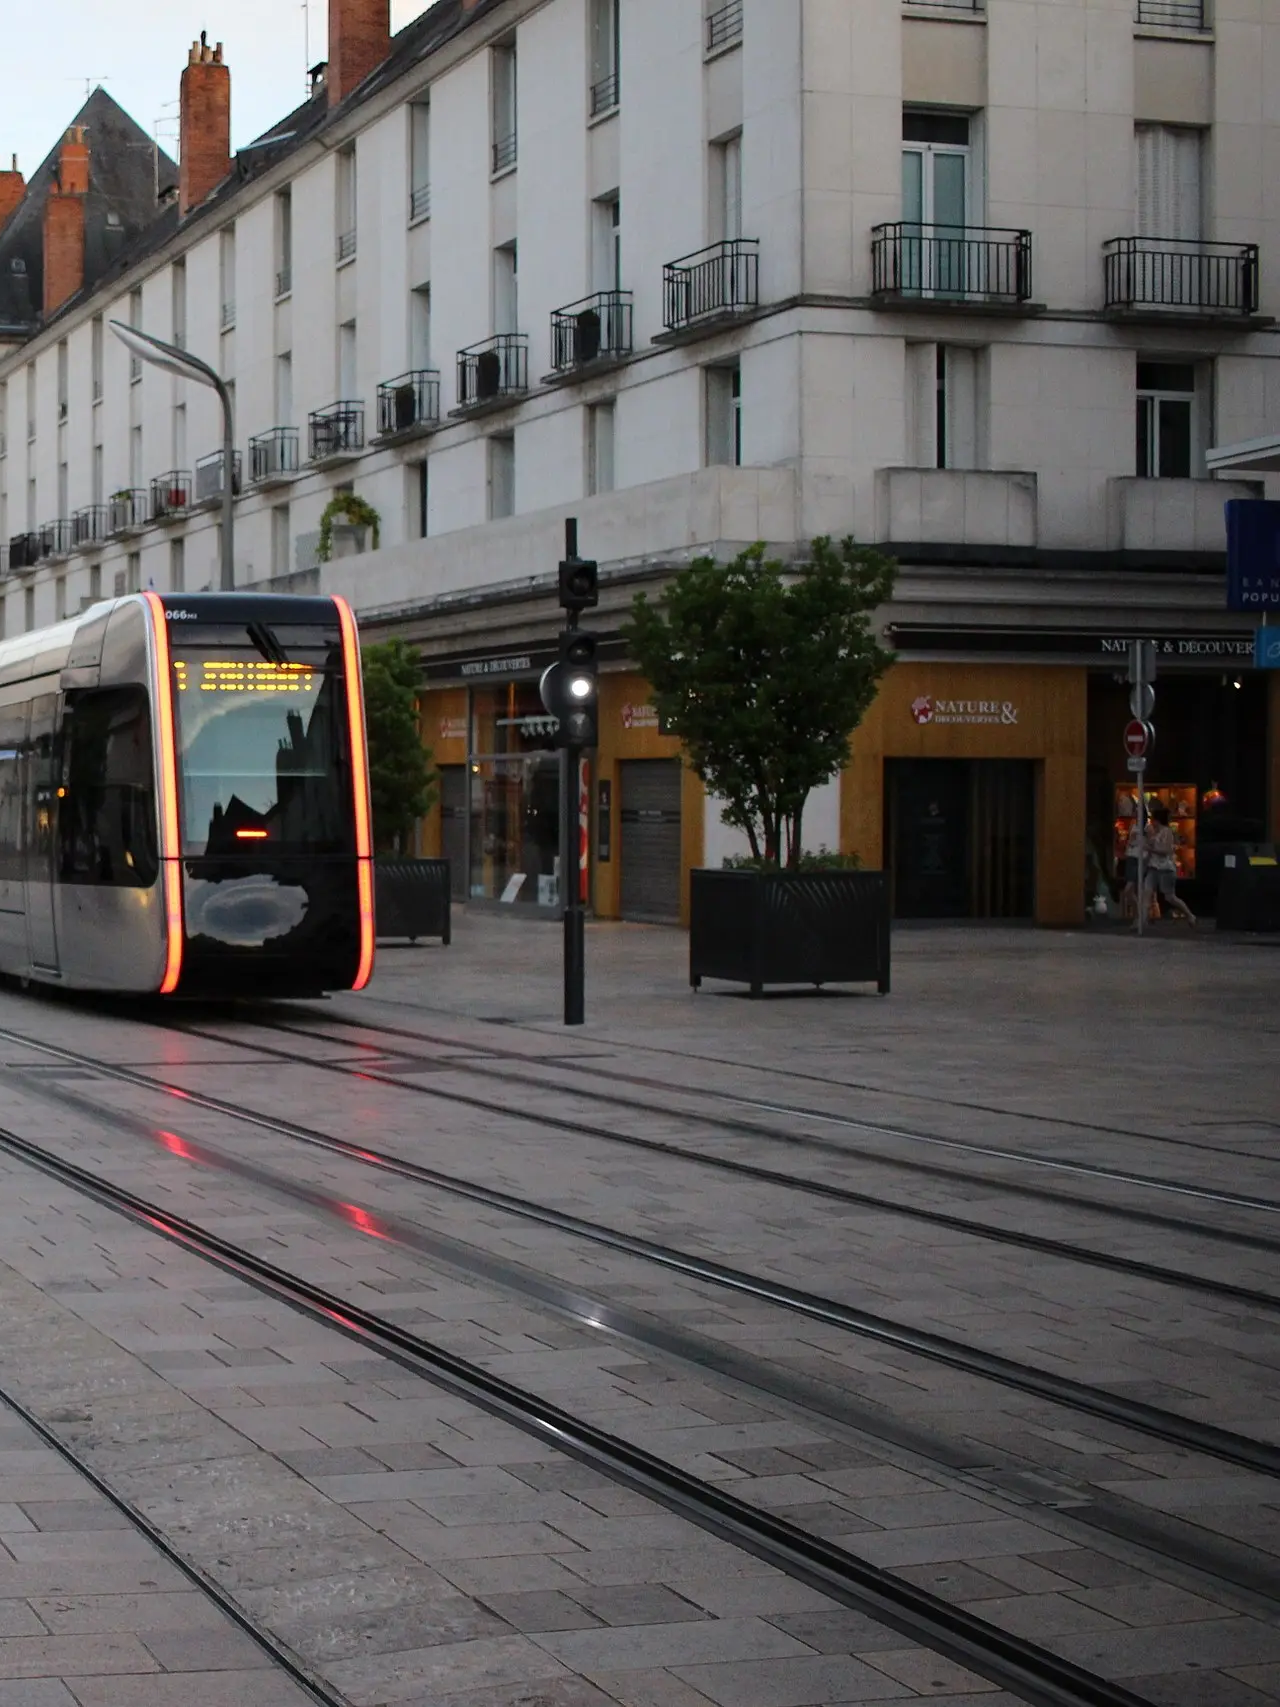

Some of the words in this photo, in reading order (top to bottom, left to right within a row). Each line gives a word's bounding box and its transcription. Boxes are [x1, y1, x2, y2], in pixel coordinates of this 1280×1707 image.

[1101, 639, 1161, 653] NATE
[1163, 641, 1173, 653] &
[935, 700, 1000, 713] NATURE
[1001, 701, 1018, 724] &
